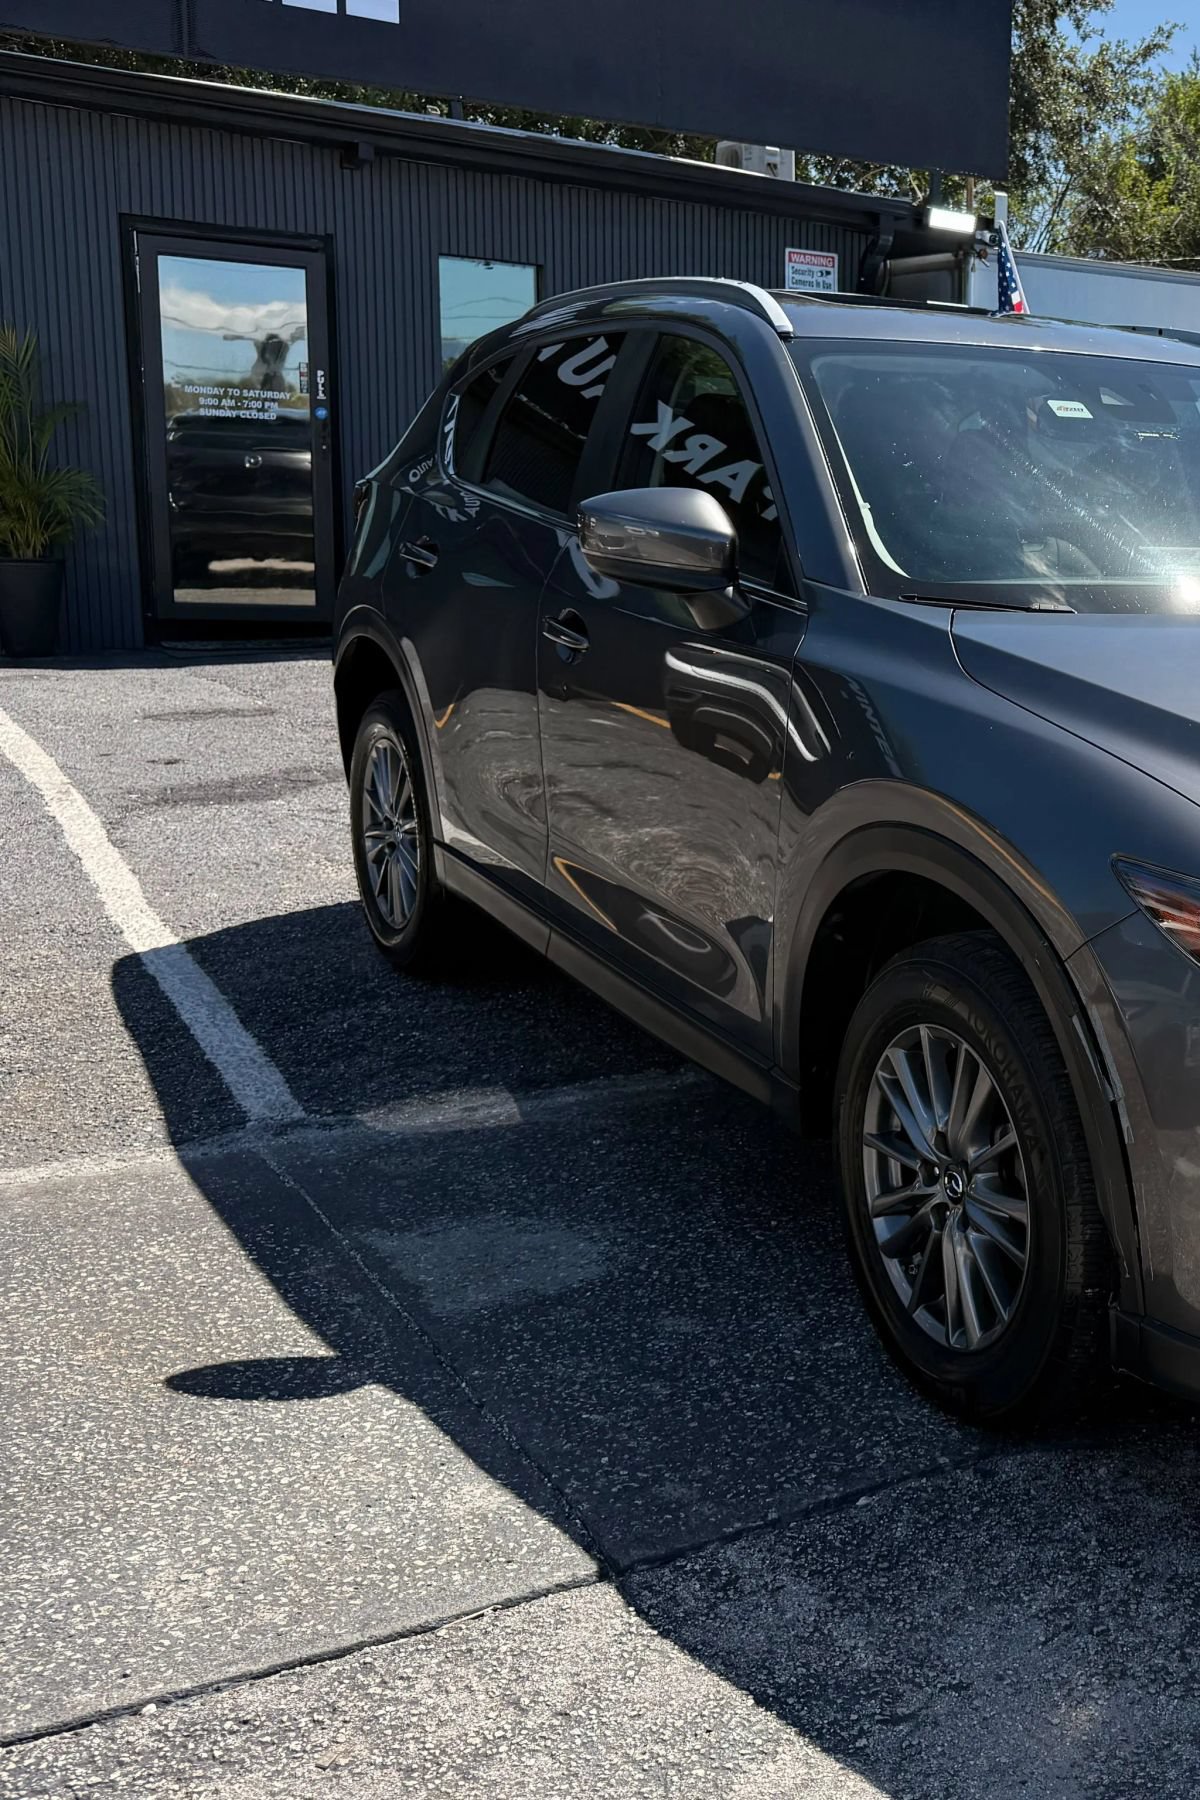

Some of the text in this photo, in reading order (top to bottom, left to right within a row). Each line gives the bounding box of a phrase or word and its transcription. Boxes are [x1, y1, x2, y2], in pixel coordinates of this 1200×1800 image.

[791, 253, 833, 267] WARNING
[791, 266, 815, 278] Security
[791, 276, 814, 287] Cameras
[823, 281, 832, 290] Use
[317, 370, 326, 399] PULL
[184, 385, 291, 399] MONDAY TO SATURDAY
[199, 397, 219, 406] 9:00
[221, 398, 235, 407] AM
[242, 400, 262, 409] 7:00
[264, 401, 279, 410] PM
[199, 408, 277, 420] SUNDAY CLOSED
